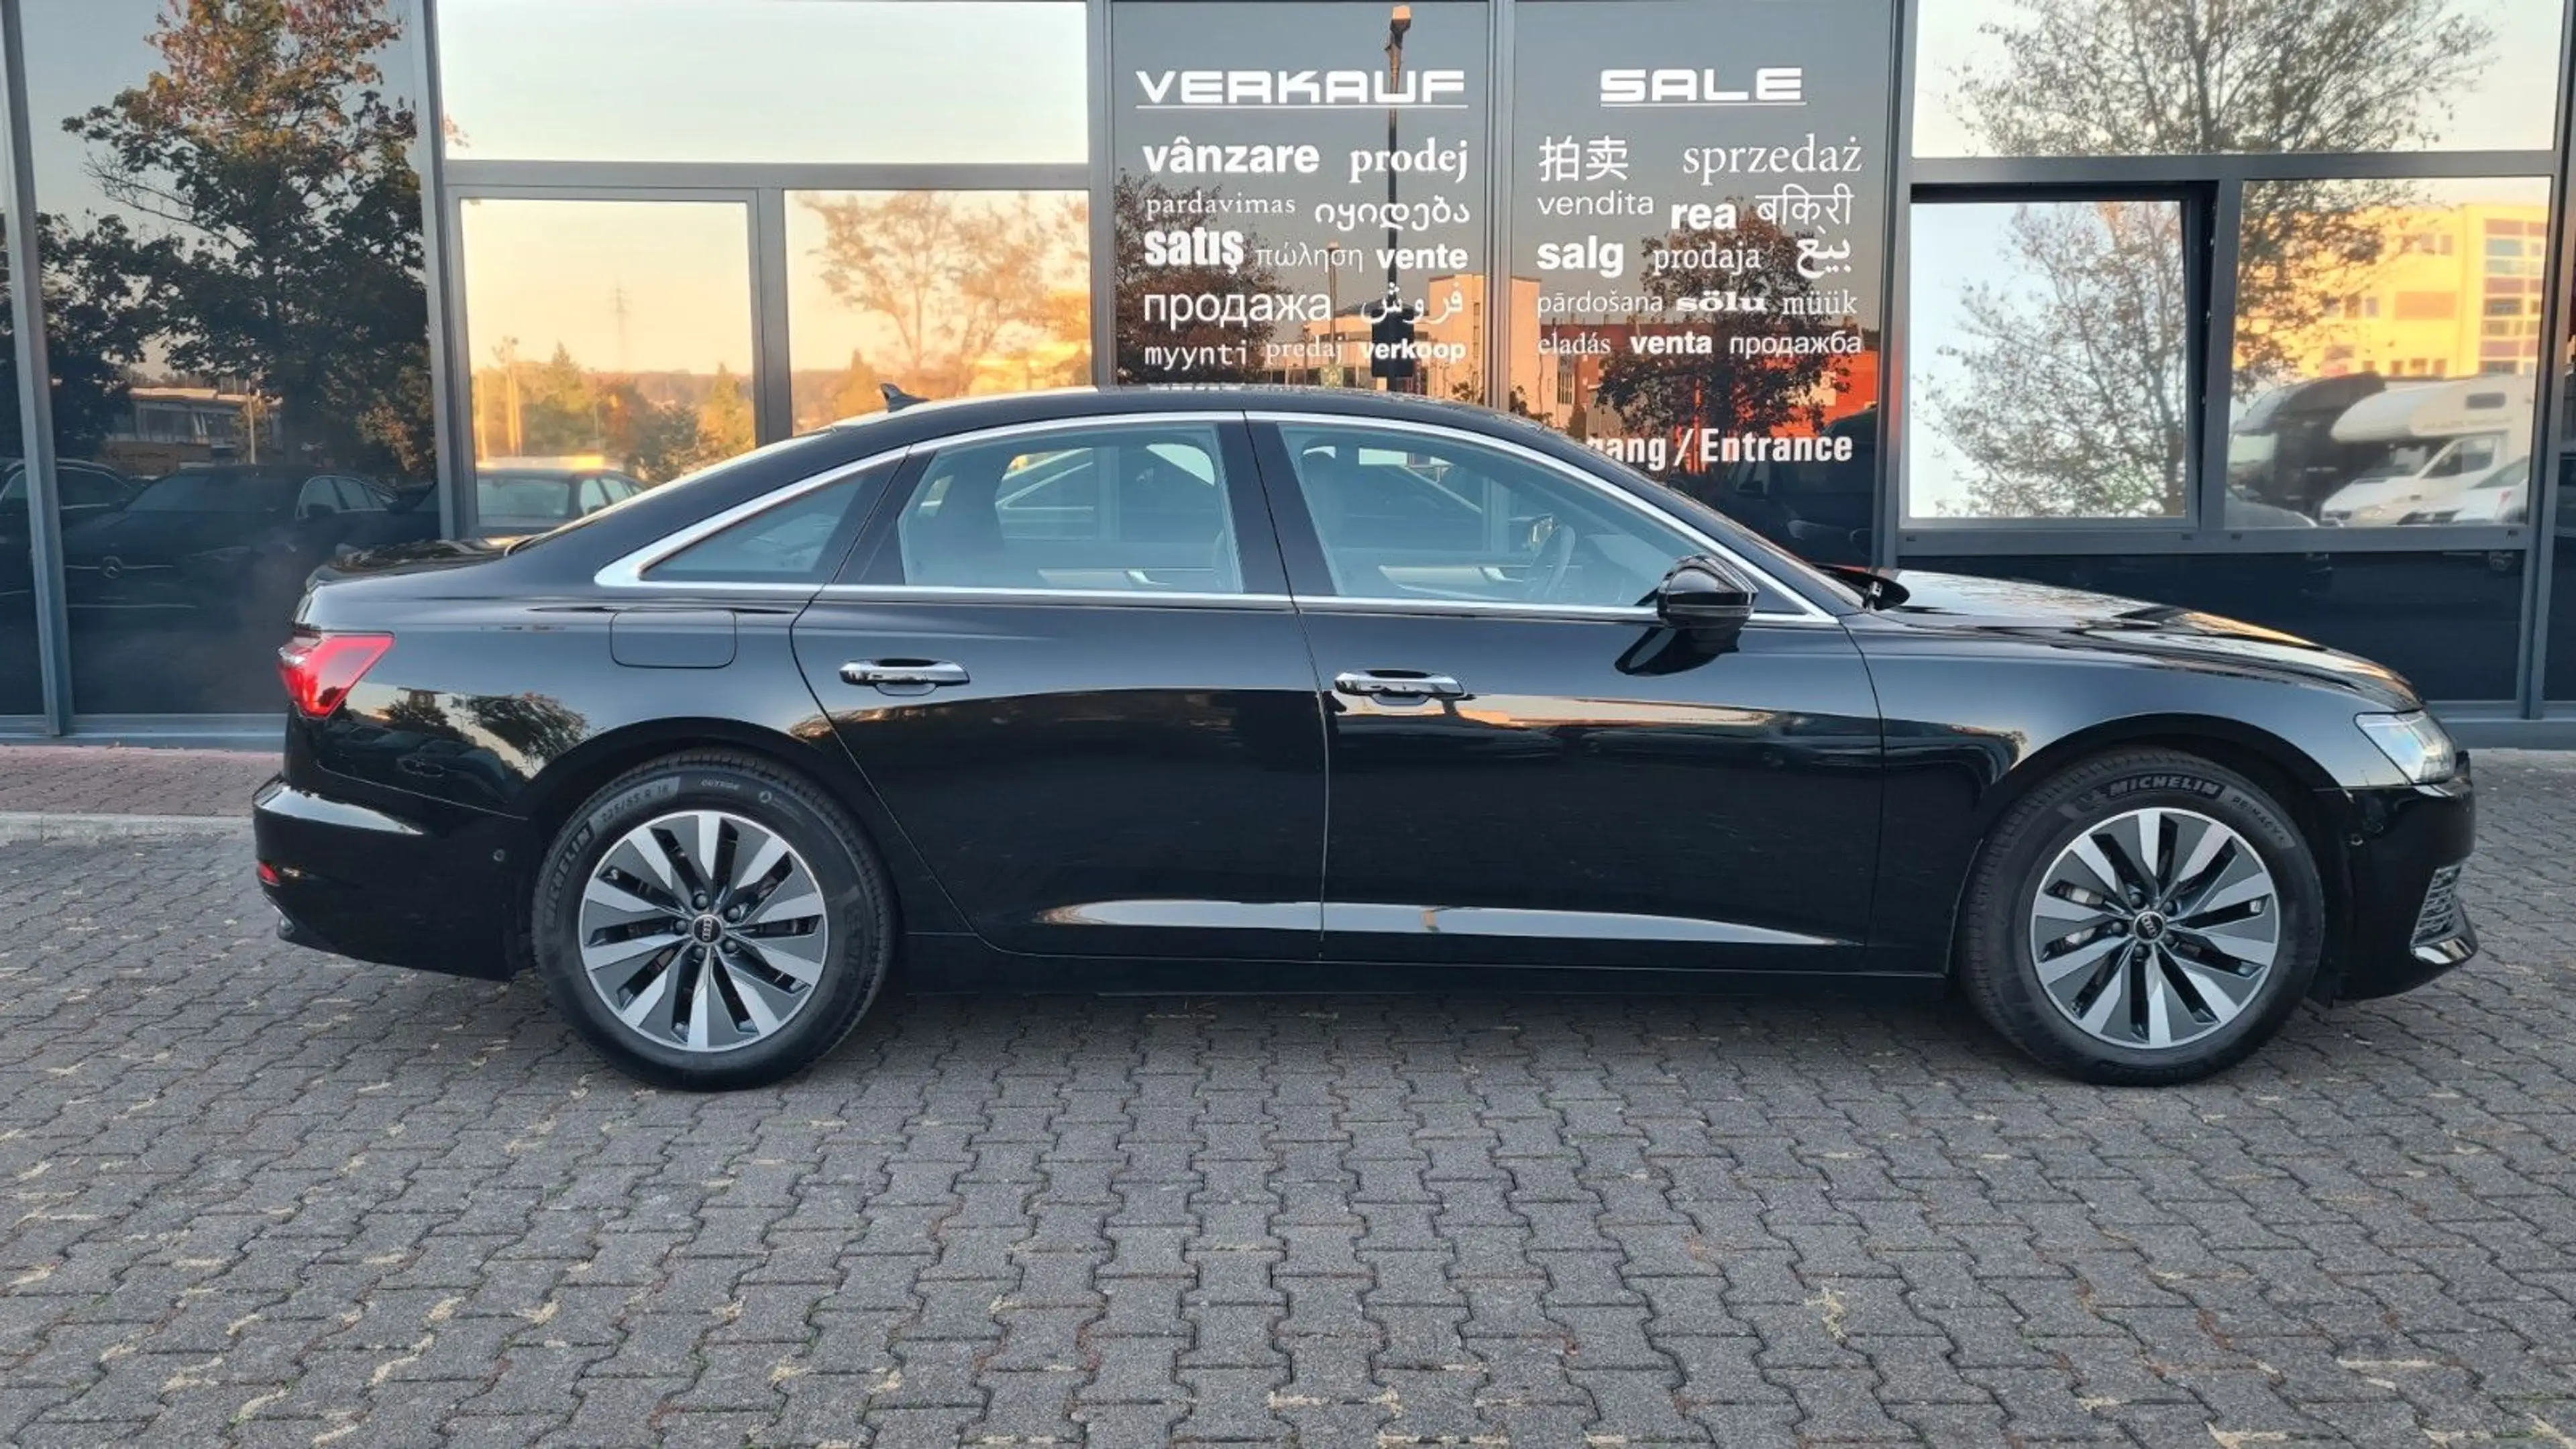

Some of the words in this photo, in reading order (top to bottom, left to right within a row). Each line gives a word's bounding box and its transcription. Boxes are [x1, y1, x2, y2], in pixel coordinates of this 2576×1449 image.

[1136, 70, 1464, 103] VERKAUF
[1601, 68, 1802, 101] SALE
[1143, 136, 1320, 173] vânzare
[1349, 137, 1467, 183] prodej
[1539, 135, 1629, 182] 拍卖
[1683, 133, 1862, 185] sprzedaż
[1146, 191, 1295, 220] pardavimas
[1315, 195, 1470, 231] იყიდება
[1537, 190, 1654, 215] vendita
[1671, 203, 1735, 229] rea
[1144, 227, 1244, 274] satış
[1255, 241, 1363, 273] πώληση
[1376, 244, 1468, 270] vente
[1537, 235, 1623, 278] salg
[1652, 241, 1762, 276] prodaja
[1144, 293, 1331, 331] продажа
[1538, 290, 1662, 317] pārdošana
[1676, 290, 1767, 312] sölu
[1782, 289, 1858, 315] müük
[1144, 339, 1246, 371] myynti
[1265, 335, 1342, 365] predaj
[1359, 338, 1466, 363] verkoop
[1537, 331, 1611, 356] eladás
[1630, 331, 1712, 355] venta
[1729, 330, 1862, 359] продажба
[1701, 428, 1852, 462] Entrance
[2109, 775, 2220, 796] MICHELIN
